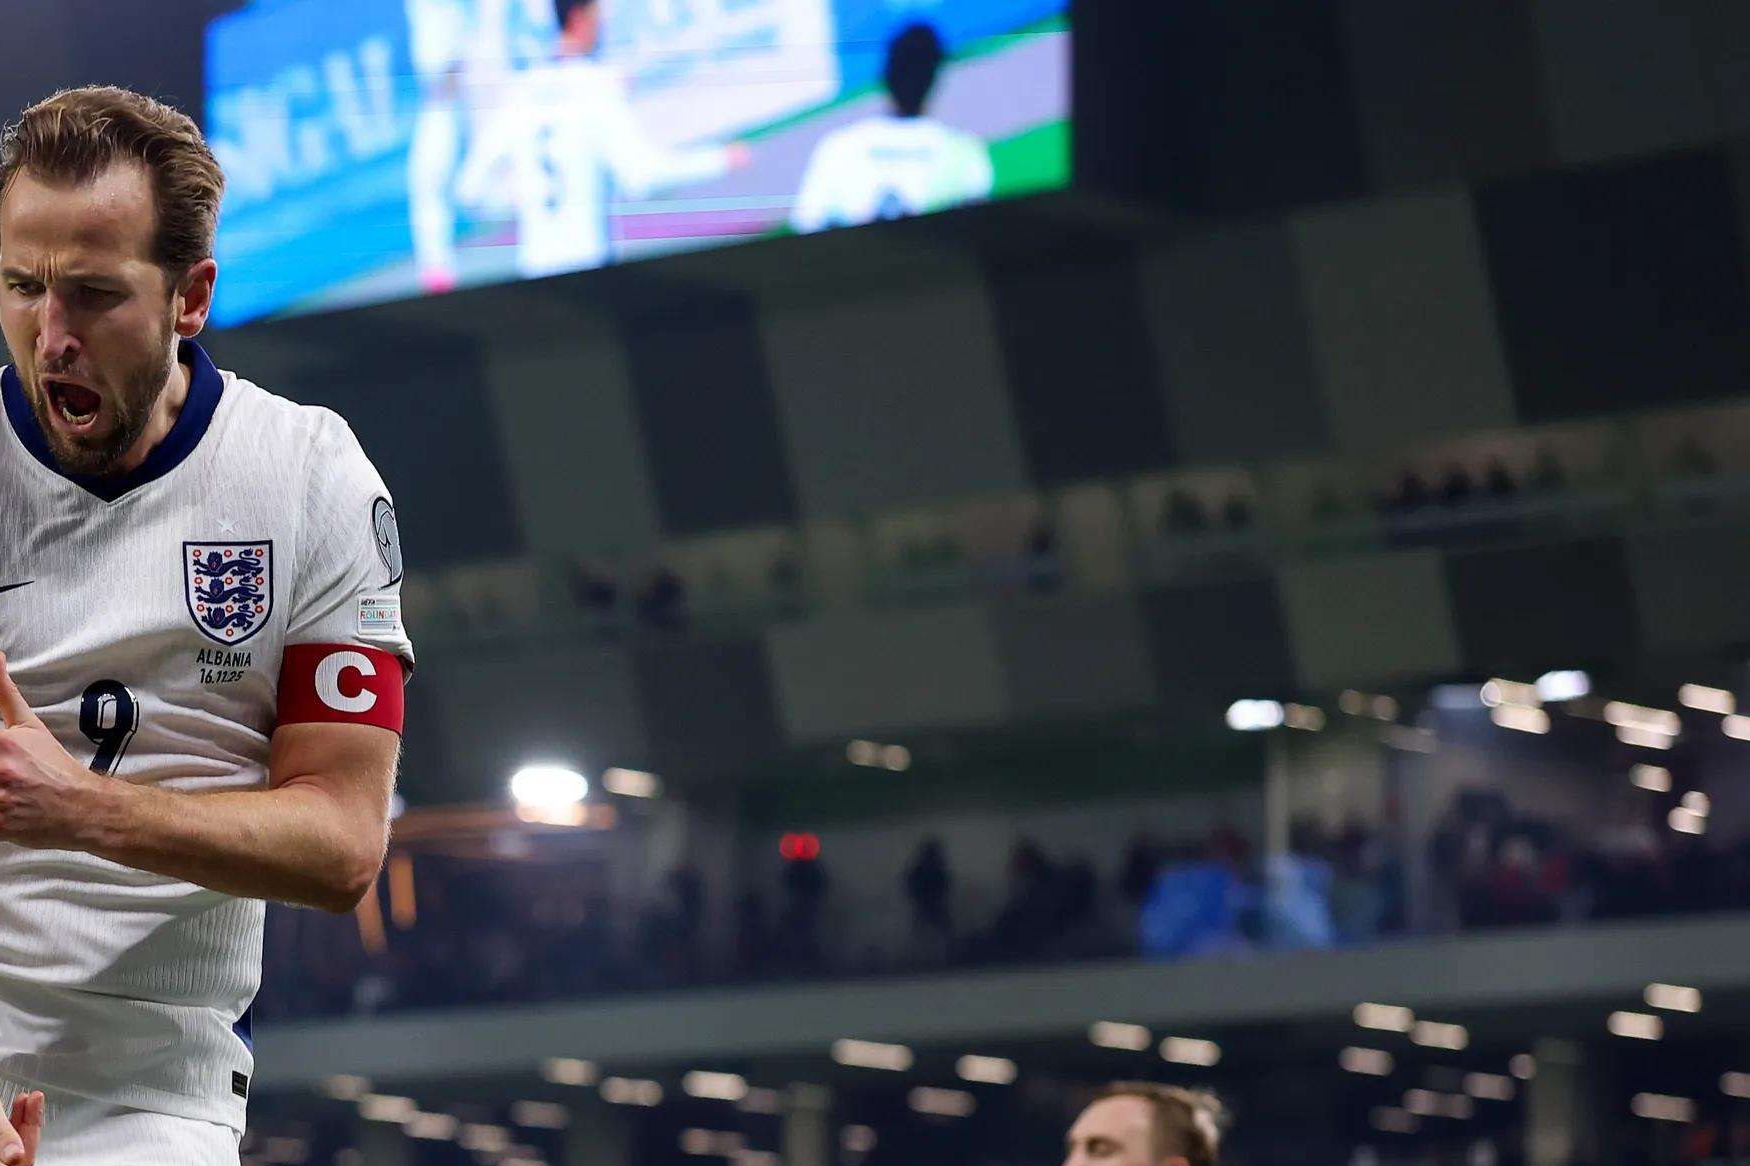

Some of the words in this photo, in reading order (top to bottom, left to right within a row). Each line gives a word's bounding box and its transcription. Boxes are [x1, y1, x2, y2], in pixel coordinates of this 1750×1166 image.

[196, 648, 251, 667] ALBANIA
[314, 650, 378, 713] C
[79, 679, 140, 777] 9
